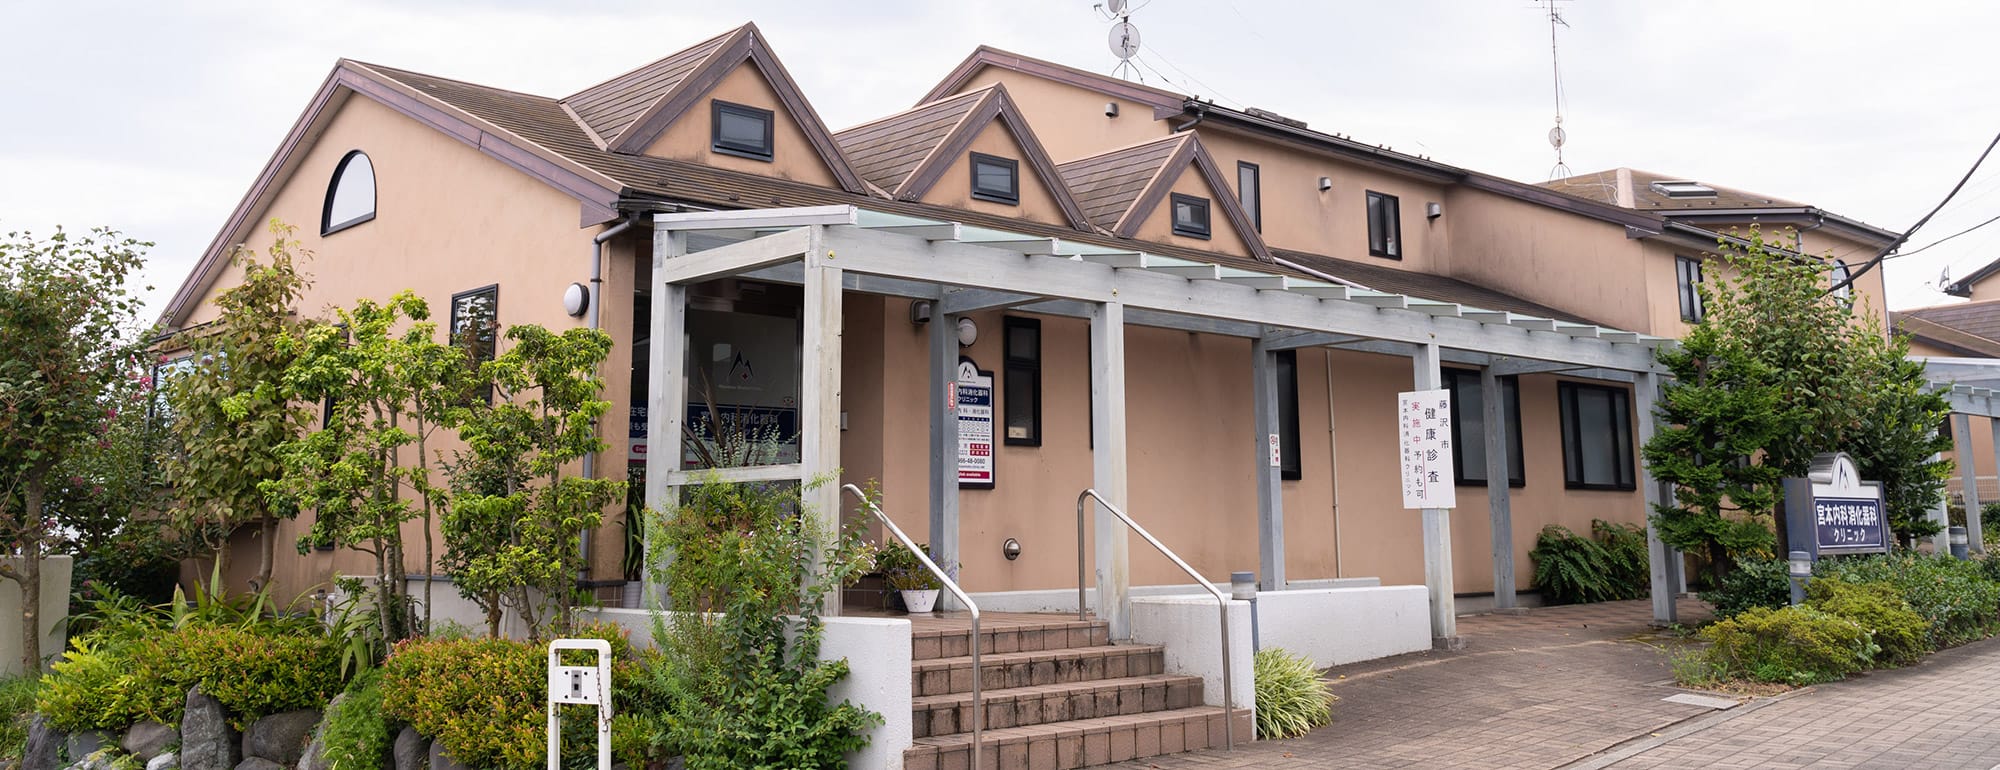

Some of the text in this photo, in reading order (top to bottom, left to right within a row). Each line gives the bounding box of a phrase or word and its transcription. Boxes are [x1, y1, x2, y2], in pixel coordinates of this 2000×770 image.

[1439, 399, 1449, 449] 藤沢市
[1425, 407, 1439, 483] 健康診査
[1816, 503, 1878, 527] 宮本内科消化器科
[1833, 527, 1866, 543] クリニック
